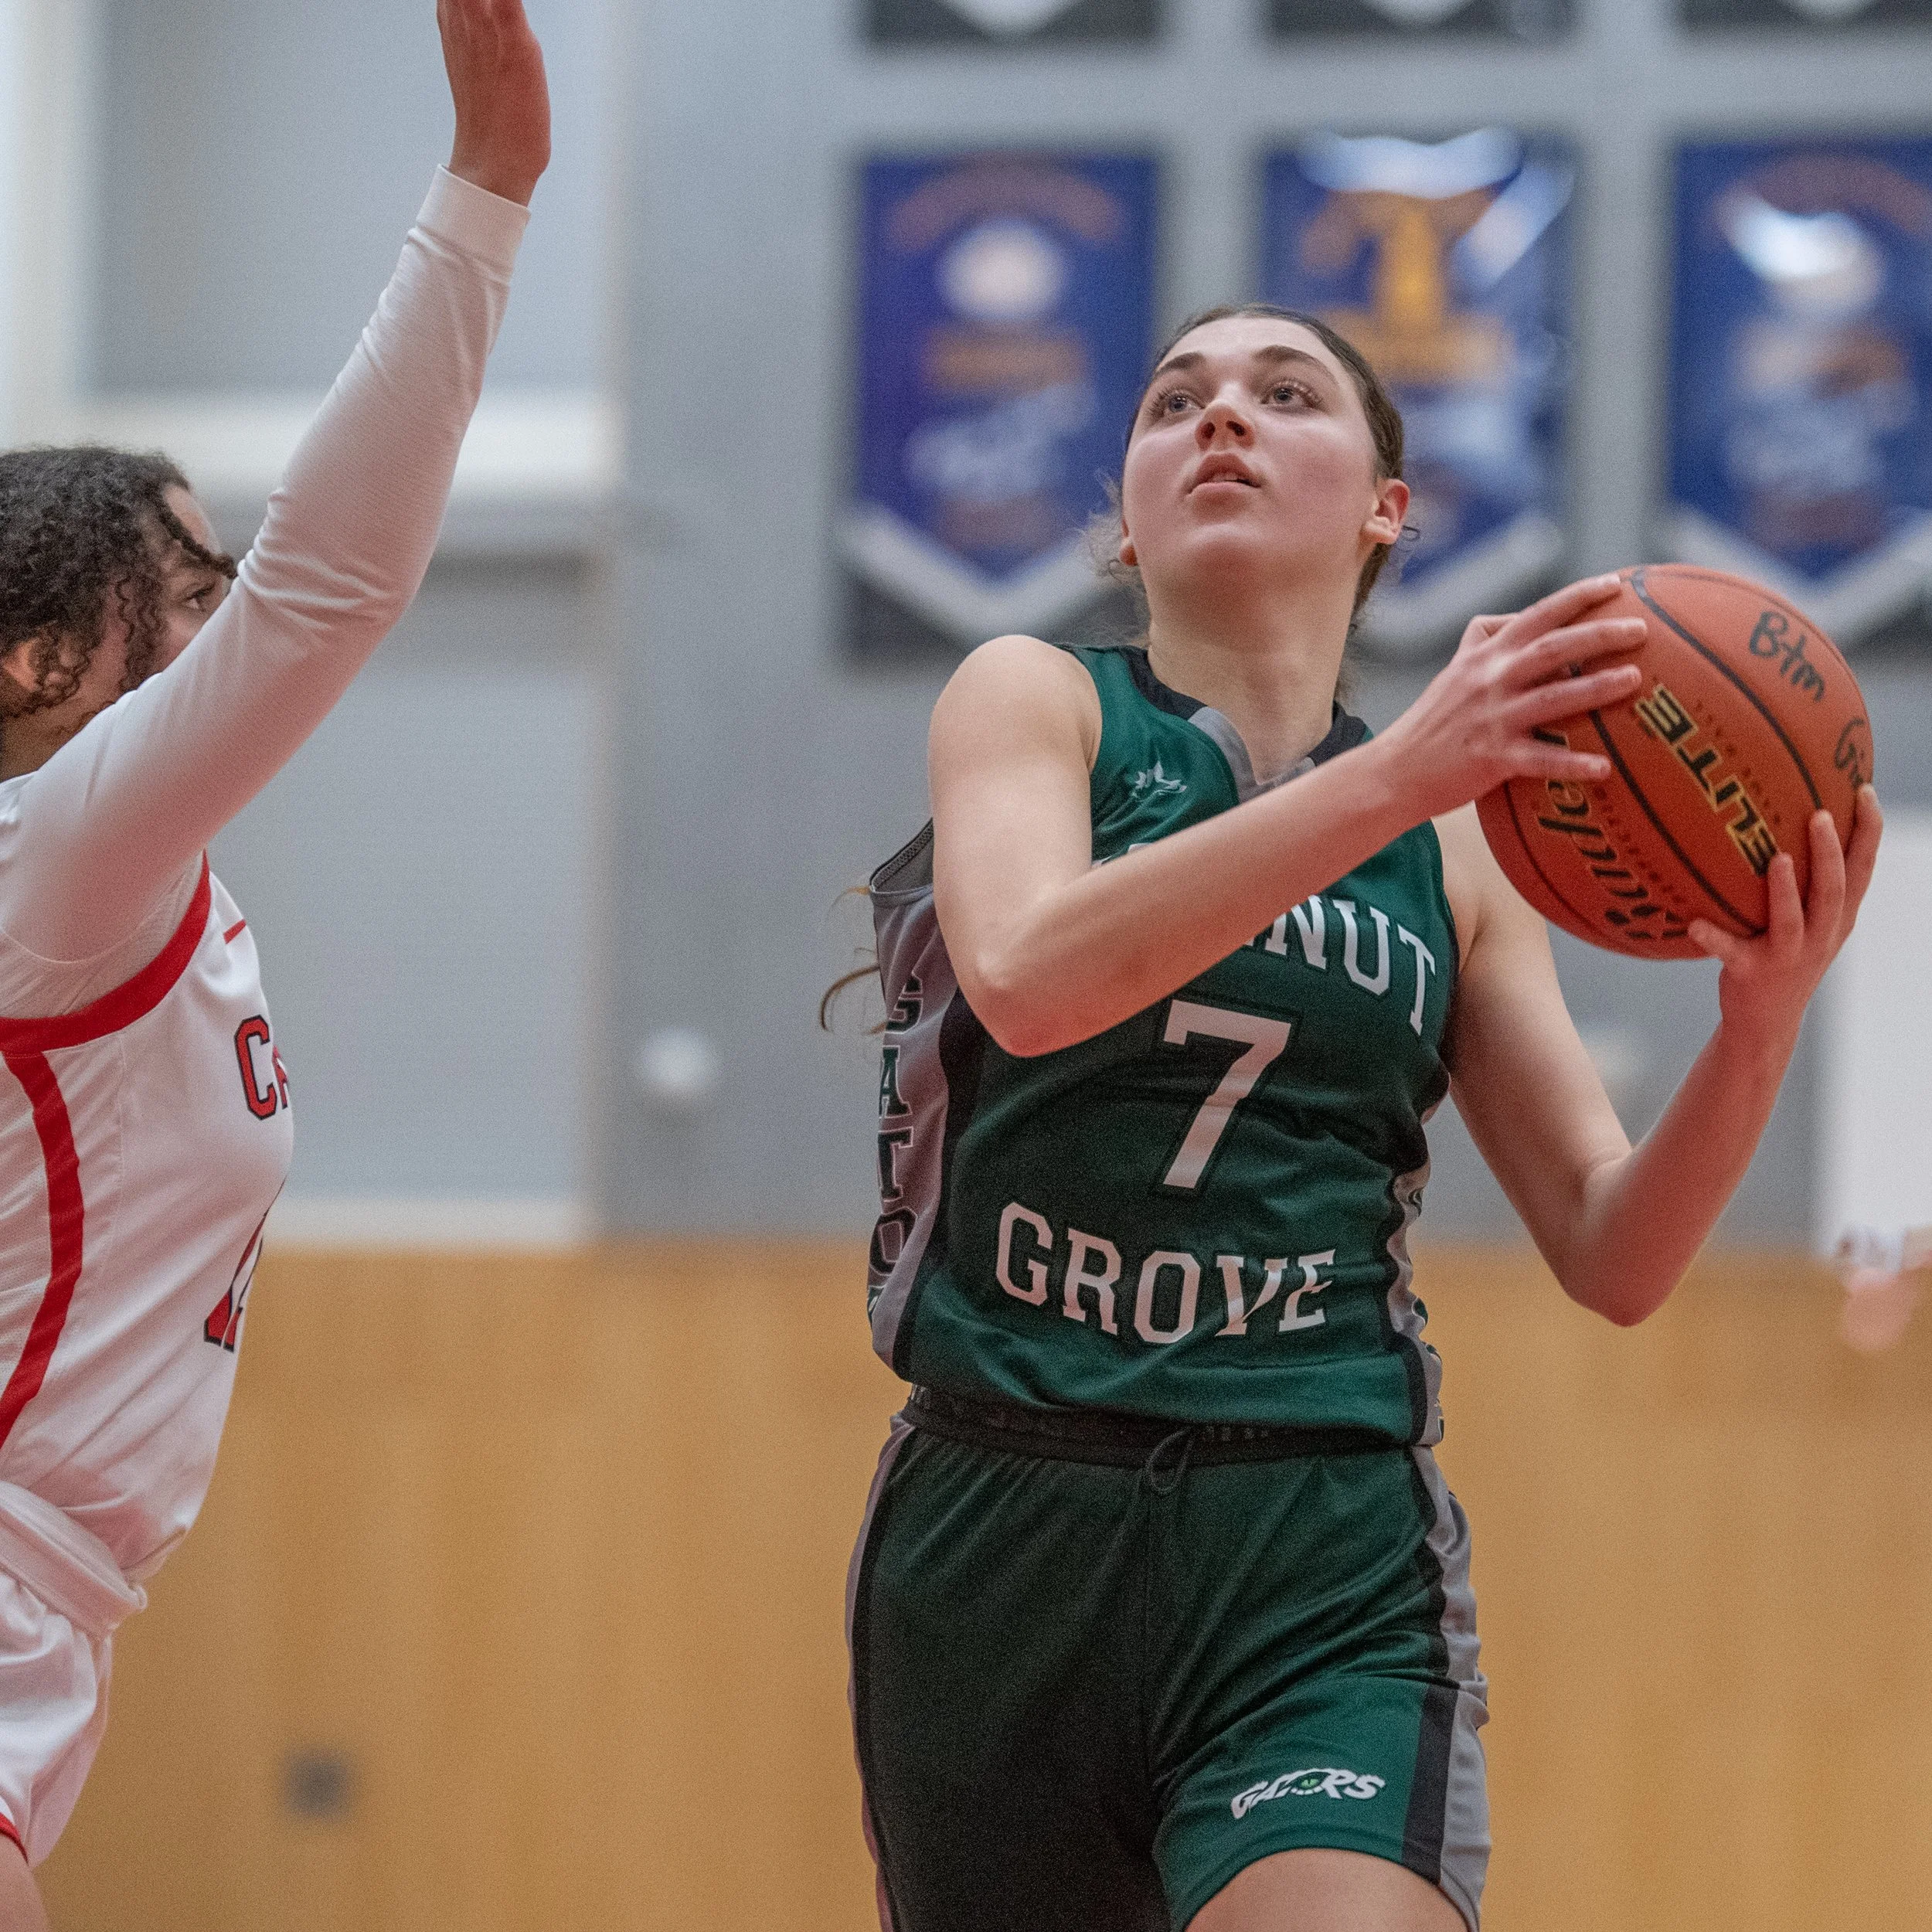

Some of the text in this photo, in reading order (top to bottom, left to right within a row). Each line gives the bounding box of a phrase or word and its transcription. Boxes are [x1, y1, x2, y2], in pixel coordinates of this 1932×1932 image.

[1750, 611, 1825, 702] Btm
[1634, 683, 1780, 878] ELITE
[1164, 999, 1291, 1189] 7
[995, 1201, 1337, 1345] GROVE
